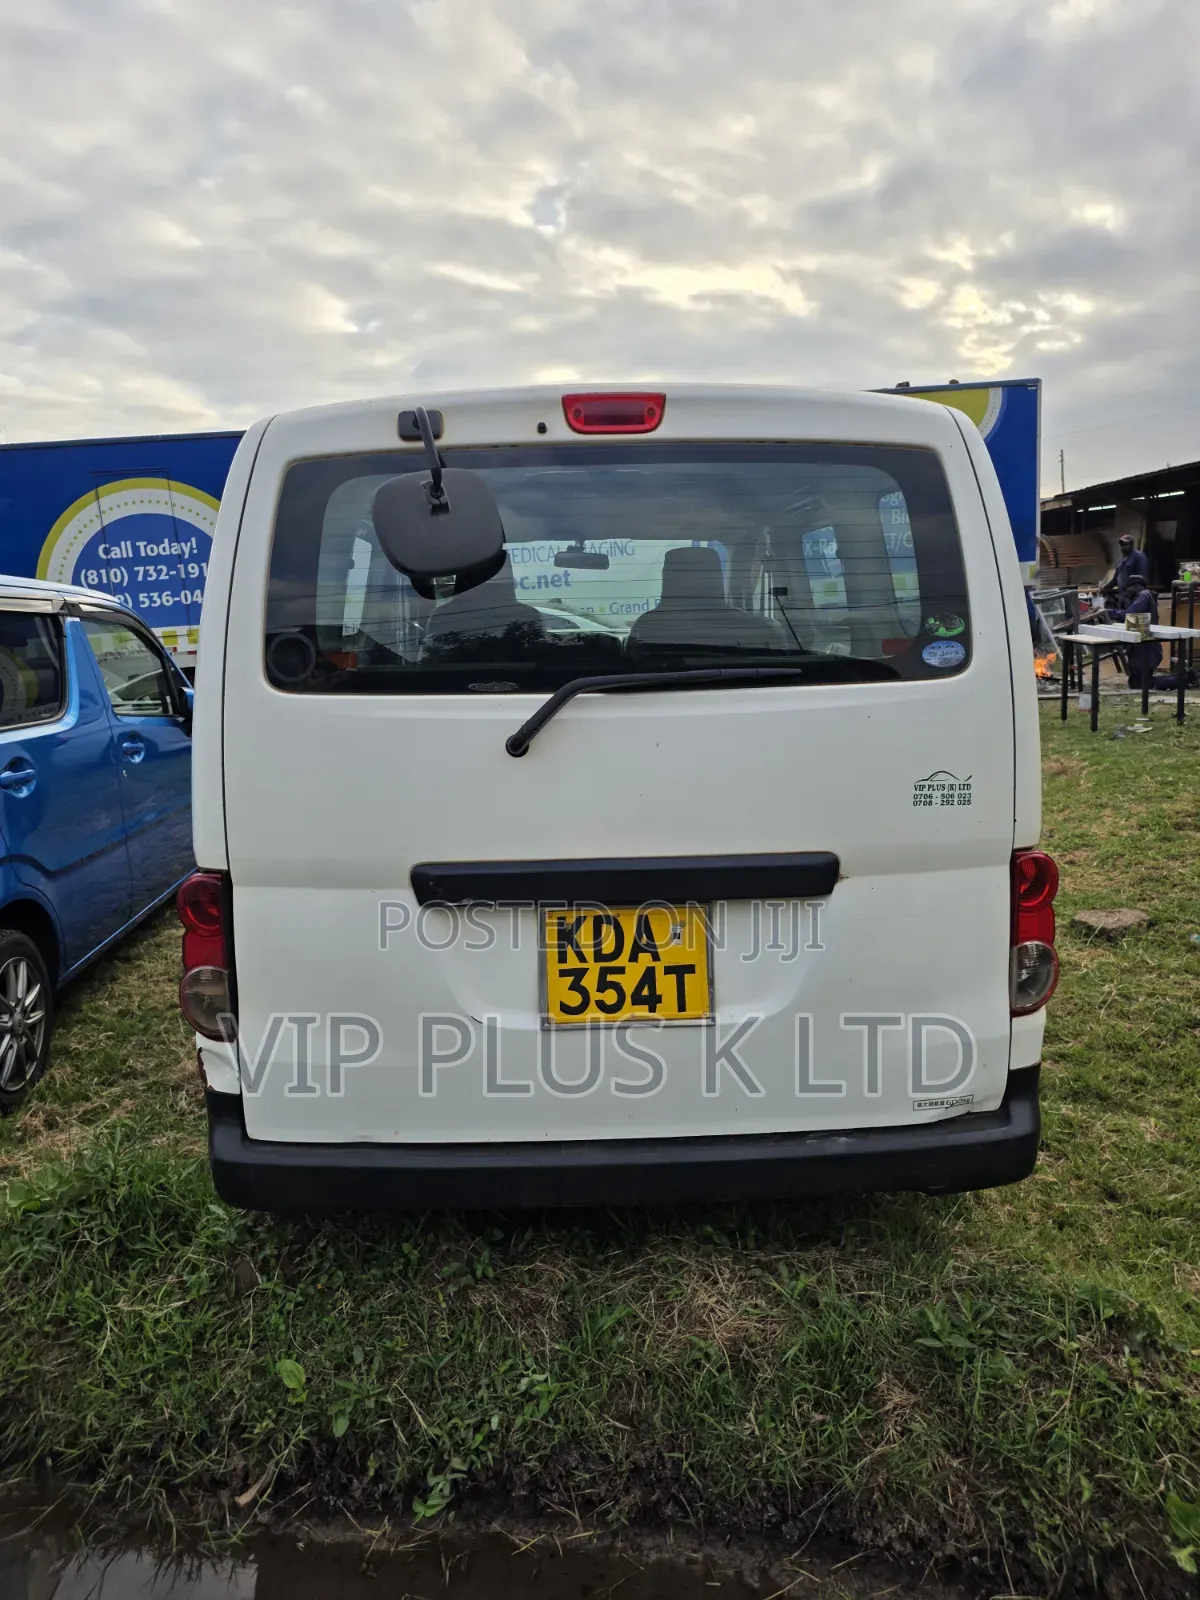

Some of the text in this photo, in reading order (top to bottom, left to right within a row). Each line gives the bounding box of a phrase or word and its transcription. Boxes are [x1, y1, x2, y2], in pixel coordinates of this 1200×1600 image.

[891, 508, 910, 525] Bi
[98, 537, 197, 559] Call Today!
[80, 566, 128, 588] (810)
[610, 598, 649, 614] Grand
[958, 783, 972, 791] LTD
[556, 914, 662, 964] KDA
[558, 964, 696, 1015] 354T
